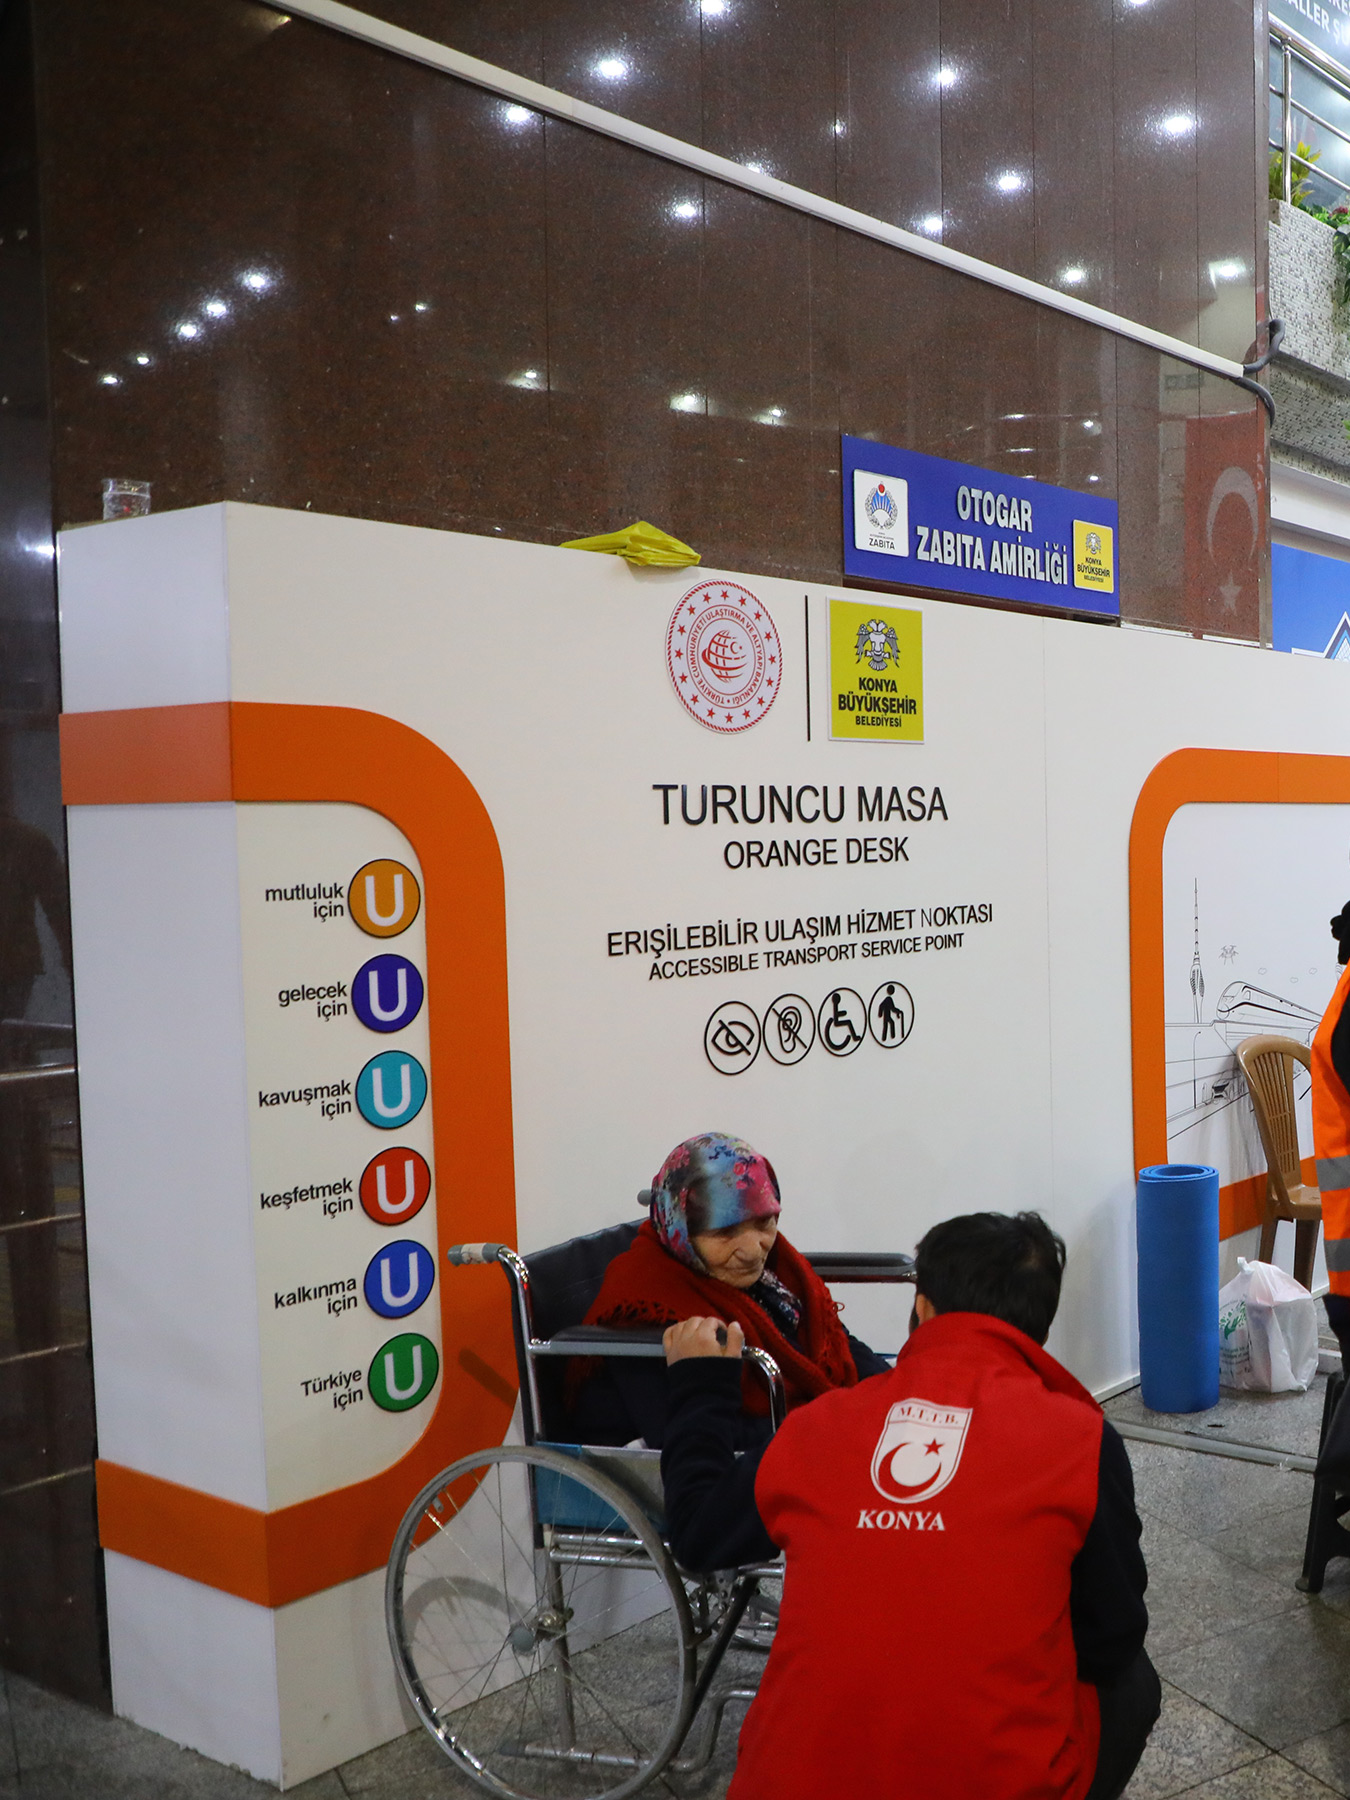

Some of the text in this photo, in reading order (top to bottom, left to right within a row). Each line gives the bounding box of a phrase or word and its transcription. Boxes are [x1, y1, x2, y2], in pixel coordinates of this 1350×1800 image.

[957, 485, 1033, 533] OTOGAR
[869, 538, 896, 550] ZABITA
[916, 525, 1068, 586] ZABITA AMİRLİĞİ
[746, 622, 755, 634] VE
[859, 677, 898, 693] KONYA
[838, 691, 917, 716] BÜYÜKŞEHİR
[855, 714, 902, 727] BELEDİYESİ
[652, 783, 949, 826] TURUNCU MASA
[723, 836, 910, 869] ORANGE DESK
[265, 882, 344, 902] mutluluk
[313, 901, 344, 923] için
[607, 903, 993, 959] ERIŞİLEBİLİR ULAŞIM HİZMET NOKTASI
[649, 933, 965, 981] ACCESSIBLE TRANSPORT SERVICE POINT
[278, 981, 348, 1008] gelecek
[317, 1000, 348, 1022] için
[259, 1079, 352, 1108] kavuşmak
[321, 1099, 352, 1121] için
[260, 1178, 353, 1210] keşfetmek
[323, 1197, 353, 1219] için
[274, 1278, 357, 1310] kalkınma
[327, 1295, 358, 1317] için
[300, 1369, 362, 1397] Türkiye
[333, 1388, 363, 1412] için
[856, 1509, 945, 1531] KONYA
